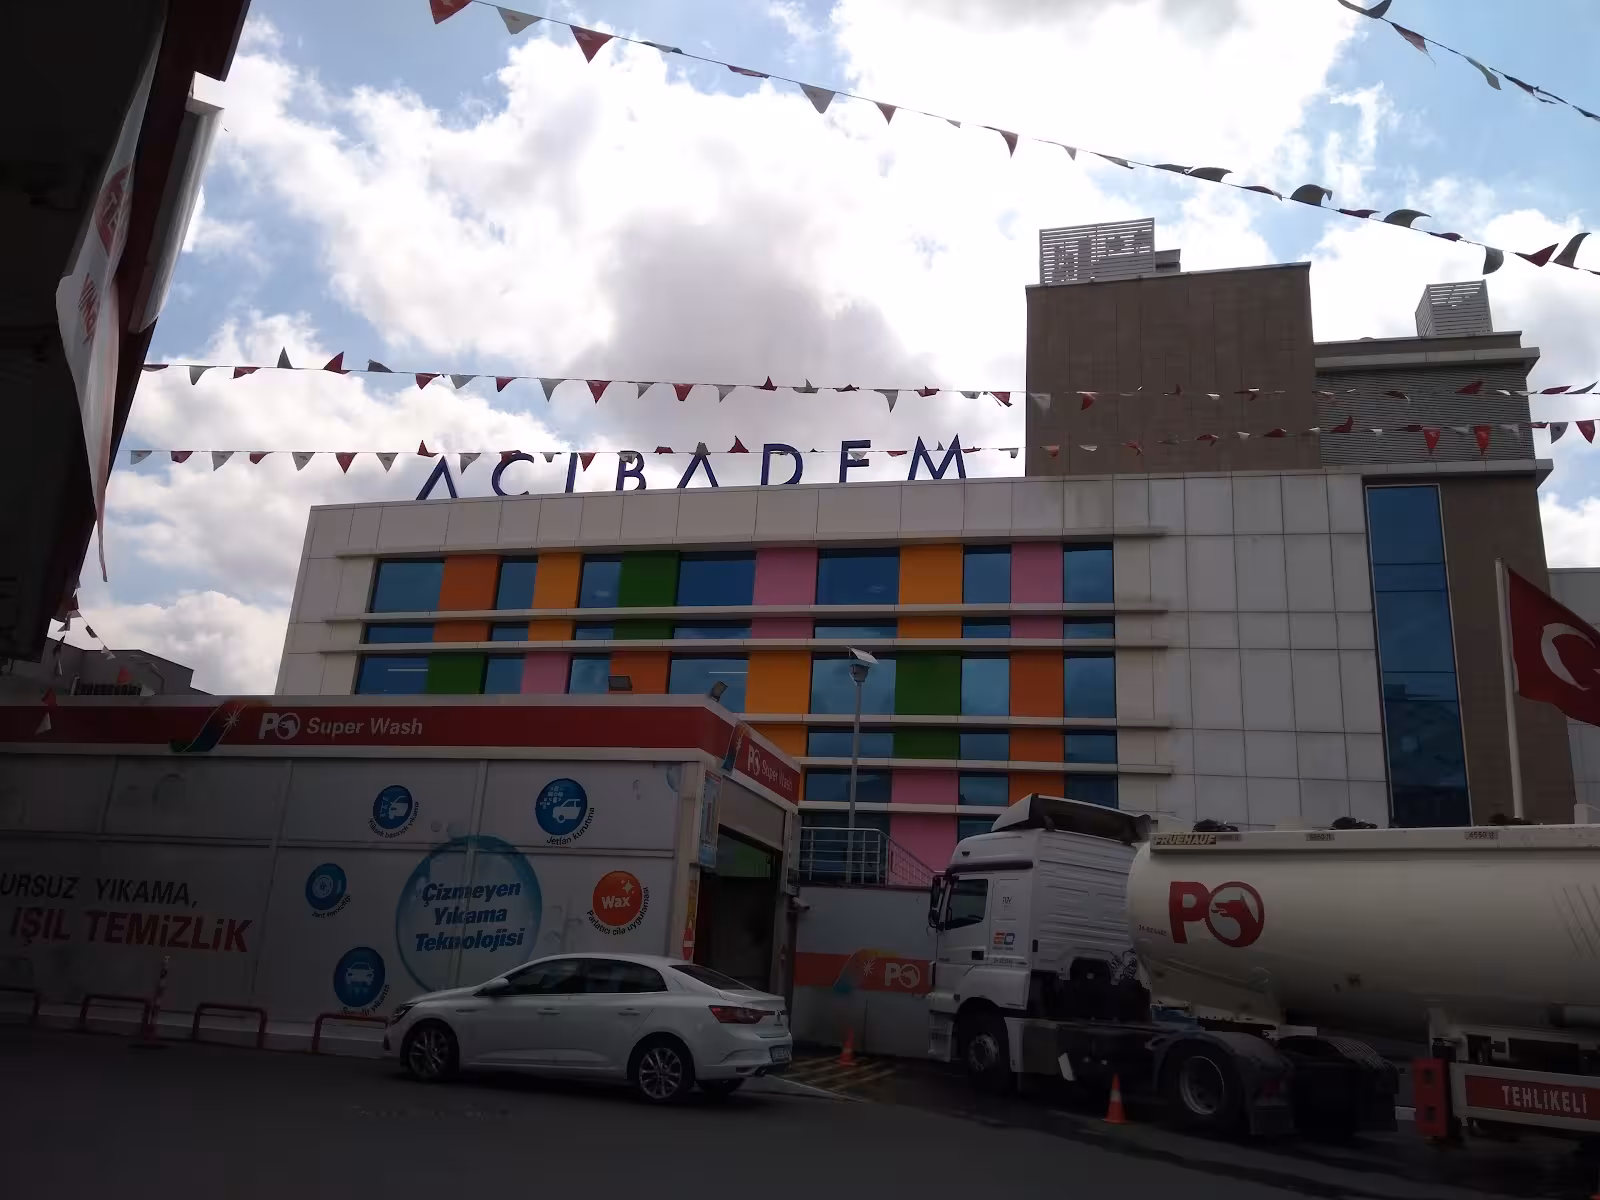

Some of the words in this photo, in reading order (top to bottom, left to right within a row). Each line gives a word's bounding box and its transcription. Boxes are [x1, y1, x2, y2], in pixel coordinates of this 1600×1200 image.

[306, 717, 365, 739] Super
[370, 717, 423, 735] Wash
[761, 759, 778, 783] Super
[571, 807, 595, 840] kurutma
[0, 872, 80, 899] URSUZ
[422, 882, 521, 907] Çizmeyen
[600, 896, 631, 910] Wax
[434, 907, 508, 926] Yıkama
[415, 928, 526, 953] Teknolojisi
